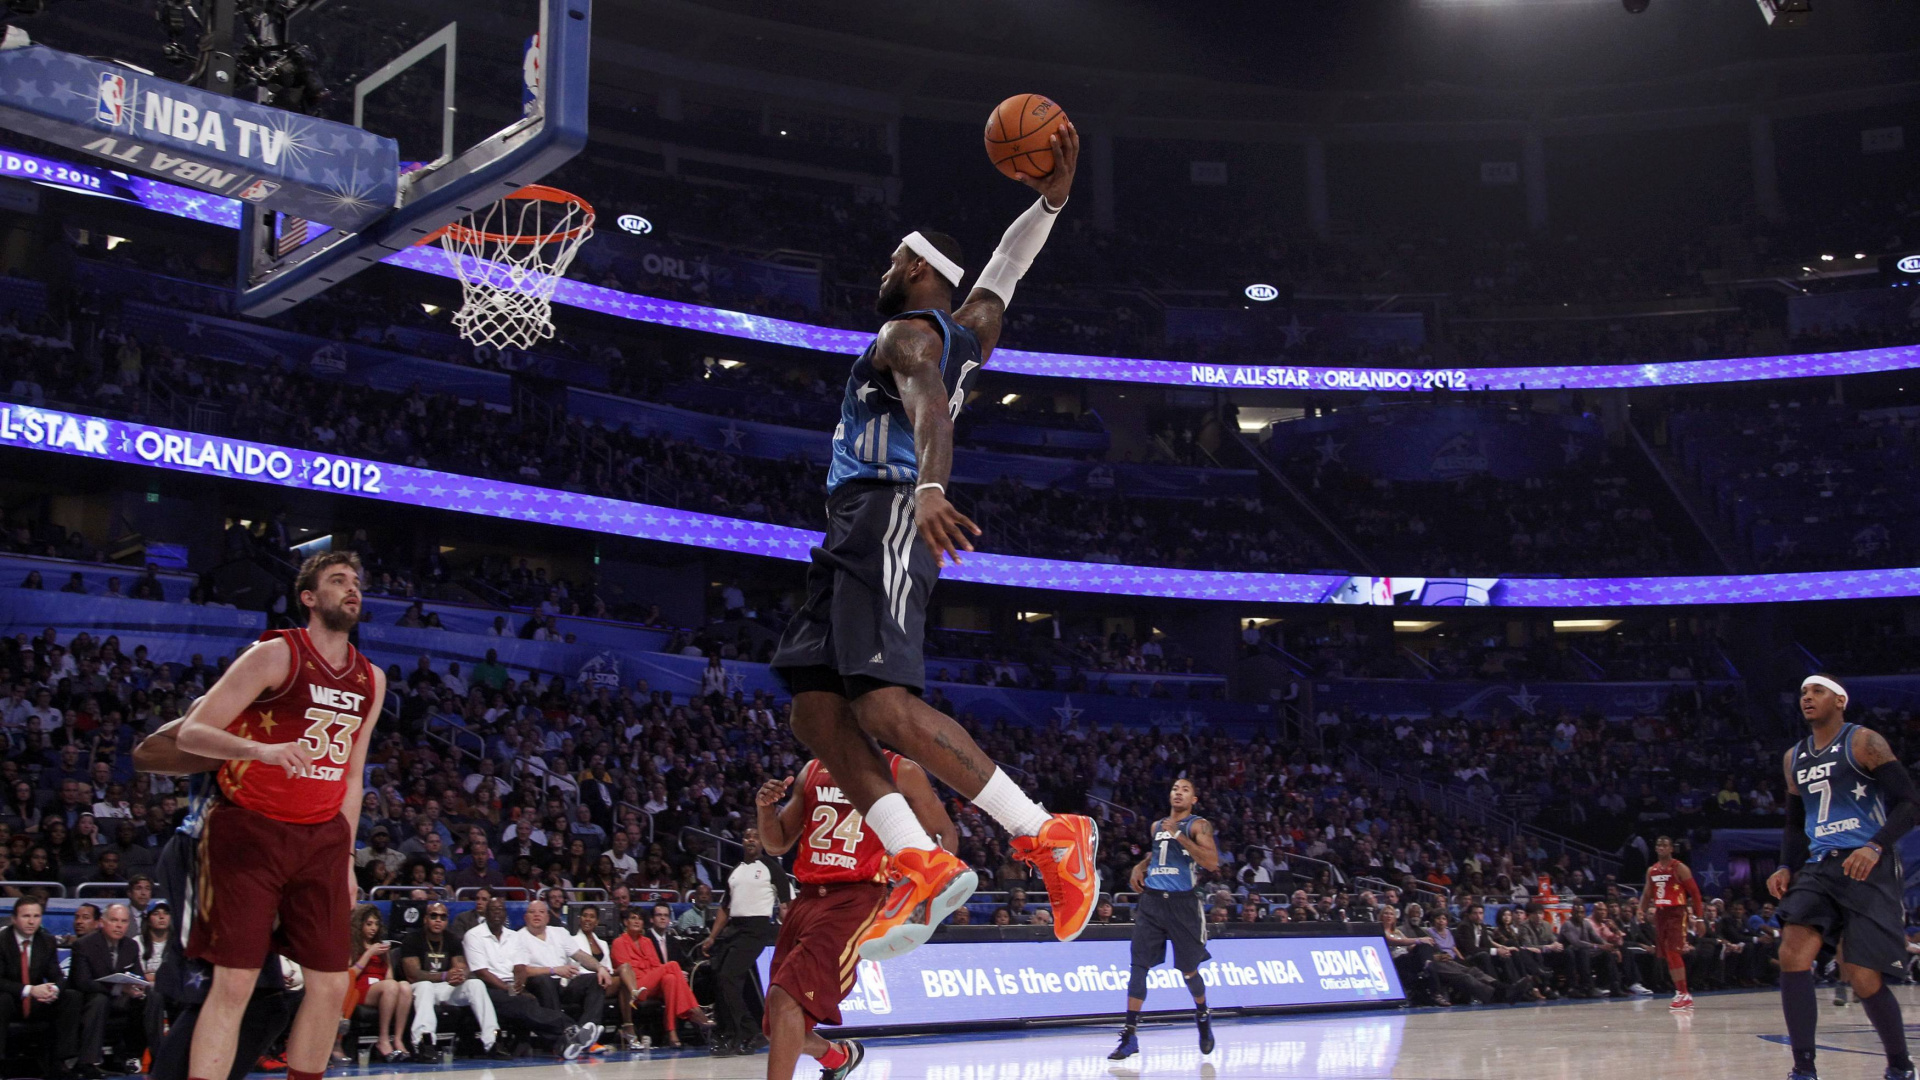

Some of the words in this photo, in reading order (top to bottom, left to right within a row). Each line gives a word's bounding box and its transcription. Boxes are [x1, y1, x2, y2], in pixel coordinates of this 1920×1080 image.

[143, 91, 226, 152] NBA
[233, 118, 285, 166] TV
[83, 137, 144, 163] TV
[56, 167, 101, 189] 2012
[151, 152, 236, 189] NBA
[1191, 365, 1229, 384] NBA
[1232, 367, 1310, 387] ALL-STAR
[1323, 370, 1412, 389] ORLANDO
[1422, 370, 1466, 389] 2012
[135, 430, 293, 480] ORLANDO
[312, 456, 382, 494] 2012
[309, 683, 366, 712] WEST
[297, 707, 362, 765] 33
[1796, 762, 1838, 785] EAST
[815, 786, 852, 805] WE
[1807, 779, 1832, 824] 7
[808, 805, 864, 854] 24
[1158, 840, 1169, 866] 1
[1310, 949, 1369, 976] BBVA
[921, 968, 996, 998] BBVA
[994, 967, 1019, 995] is
[1019, 967, 1063, 994] the
[1064, 965, 1132, 993] officia
[1198, 961, 1221, 987] of
[1221, 961, 1259, 986] the
[1256, 960, 1304, 985] NBA
[1320, 977, 1352, 990] Official
[838, 996, 867, 1011] ank
